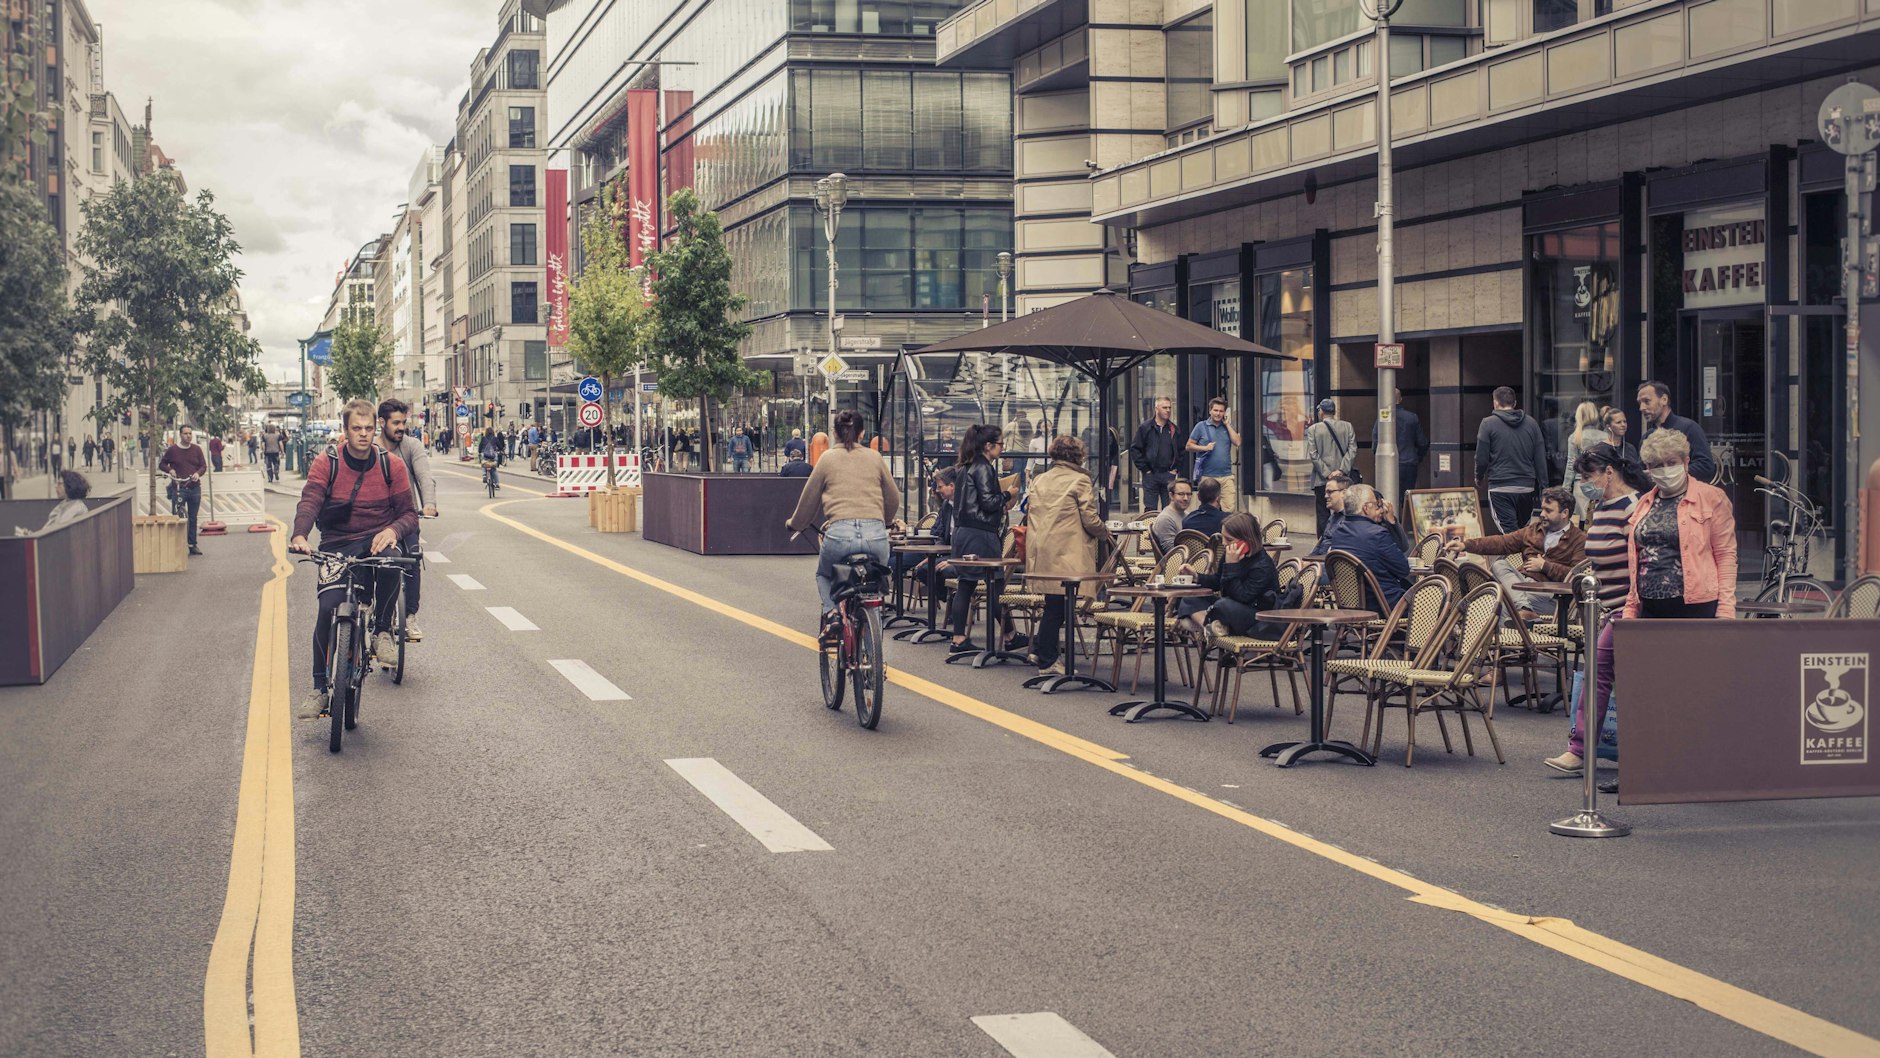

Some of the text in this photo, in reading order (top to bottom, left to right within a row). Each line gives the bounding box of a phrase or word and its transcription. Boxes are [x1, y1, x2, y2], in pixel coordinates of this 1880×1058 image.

[1682, 261, 1765, 293] KAFFE
[842, 371, 866, 379] ägerstraße
[585, 409, 599, 421] 20
[1804, 656, 1866, 667] EINSTEIN
[1806, 737, 1863, 748] KAFFEE
